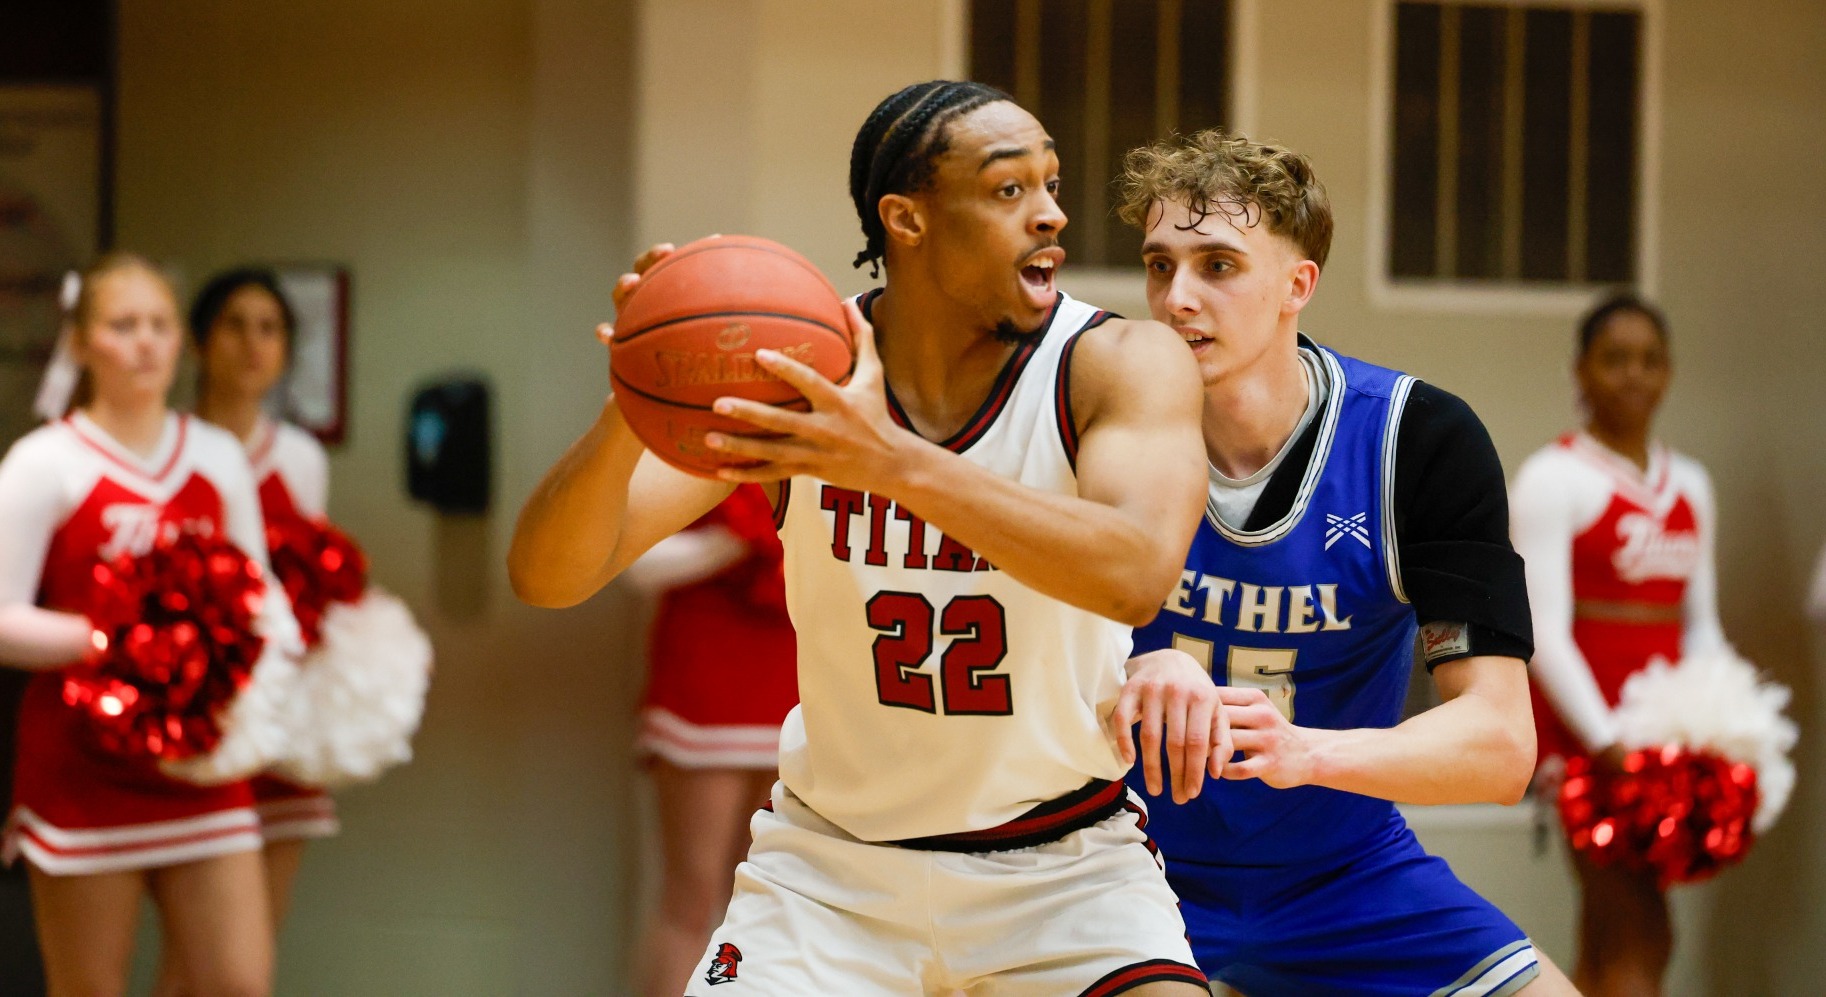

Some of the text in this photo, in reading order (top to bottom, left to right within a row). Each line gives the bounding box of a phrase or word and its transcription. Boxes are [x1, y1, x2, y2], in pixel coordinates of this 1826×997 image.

[820, 484, 1000, 573] TITA
[1163, 569, 1353, 633] ETHEL
[865, 589, 1014, 716] 22
